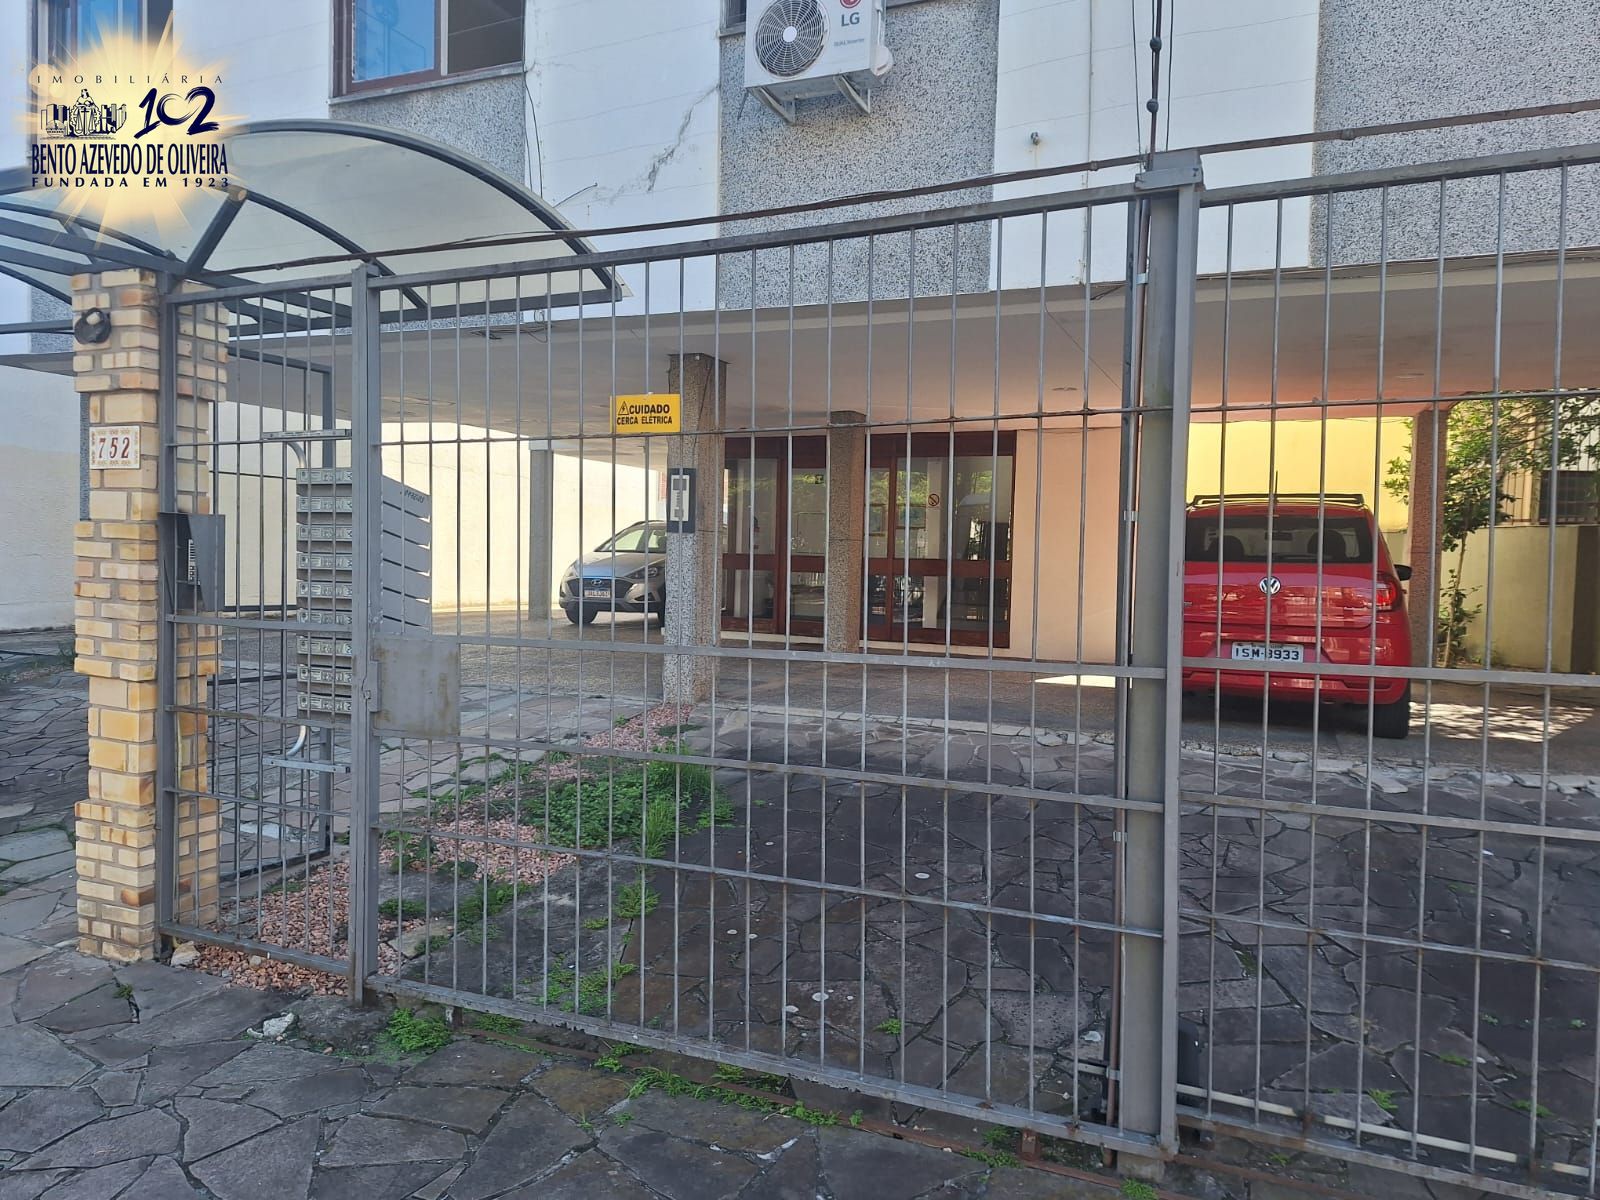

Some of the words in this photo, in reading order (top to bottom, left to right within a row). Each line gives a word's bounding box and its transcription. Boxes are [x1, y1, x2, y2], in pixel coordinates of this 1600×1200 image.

[841, 12, 860, 27] LG
[629, 404, 670, 415] CUIDADO
[616, 416, 639, 425] CERCA
[98, 436, 131, 459] 752
